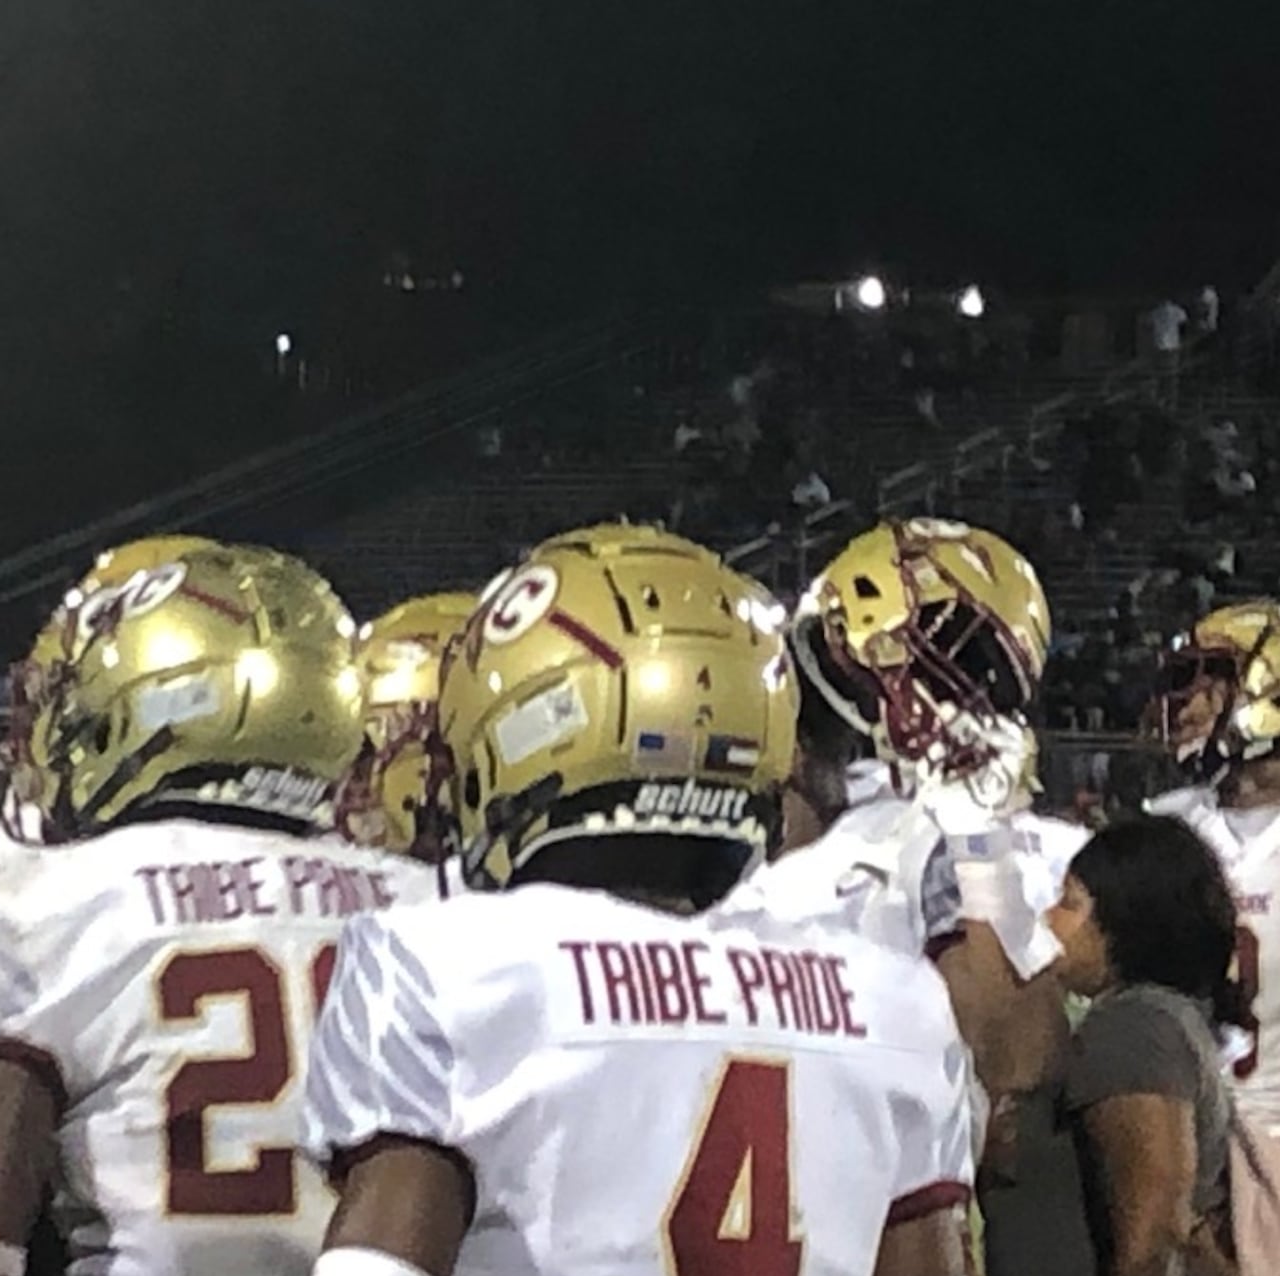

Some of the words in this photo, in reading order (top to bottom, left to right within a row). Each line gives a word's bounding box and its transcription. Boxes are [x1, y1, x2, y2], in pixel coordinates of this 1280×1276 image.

[134, 857, 276, 925] TRIBE
[559, 940, 727, 1025] TRIBE
[728, 949, 867, 1037] PRIDE
[157, 940, 338, 1217] 2
